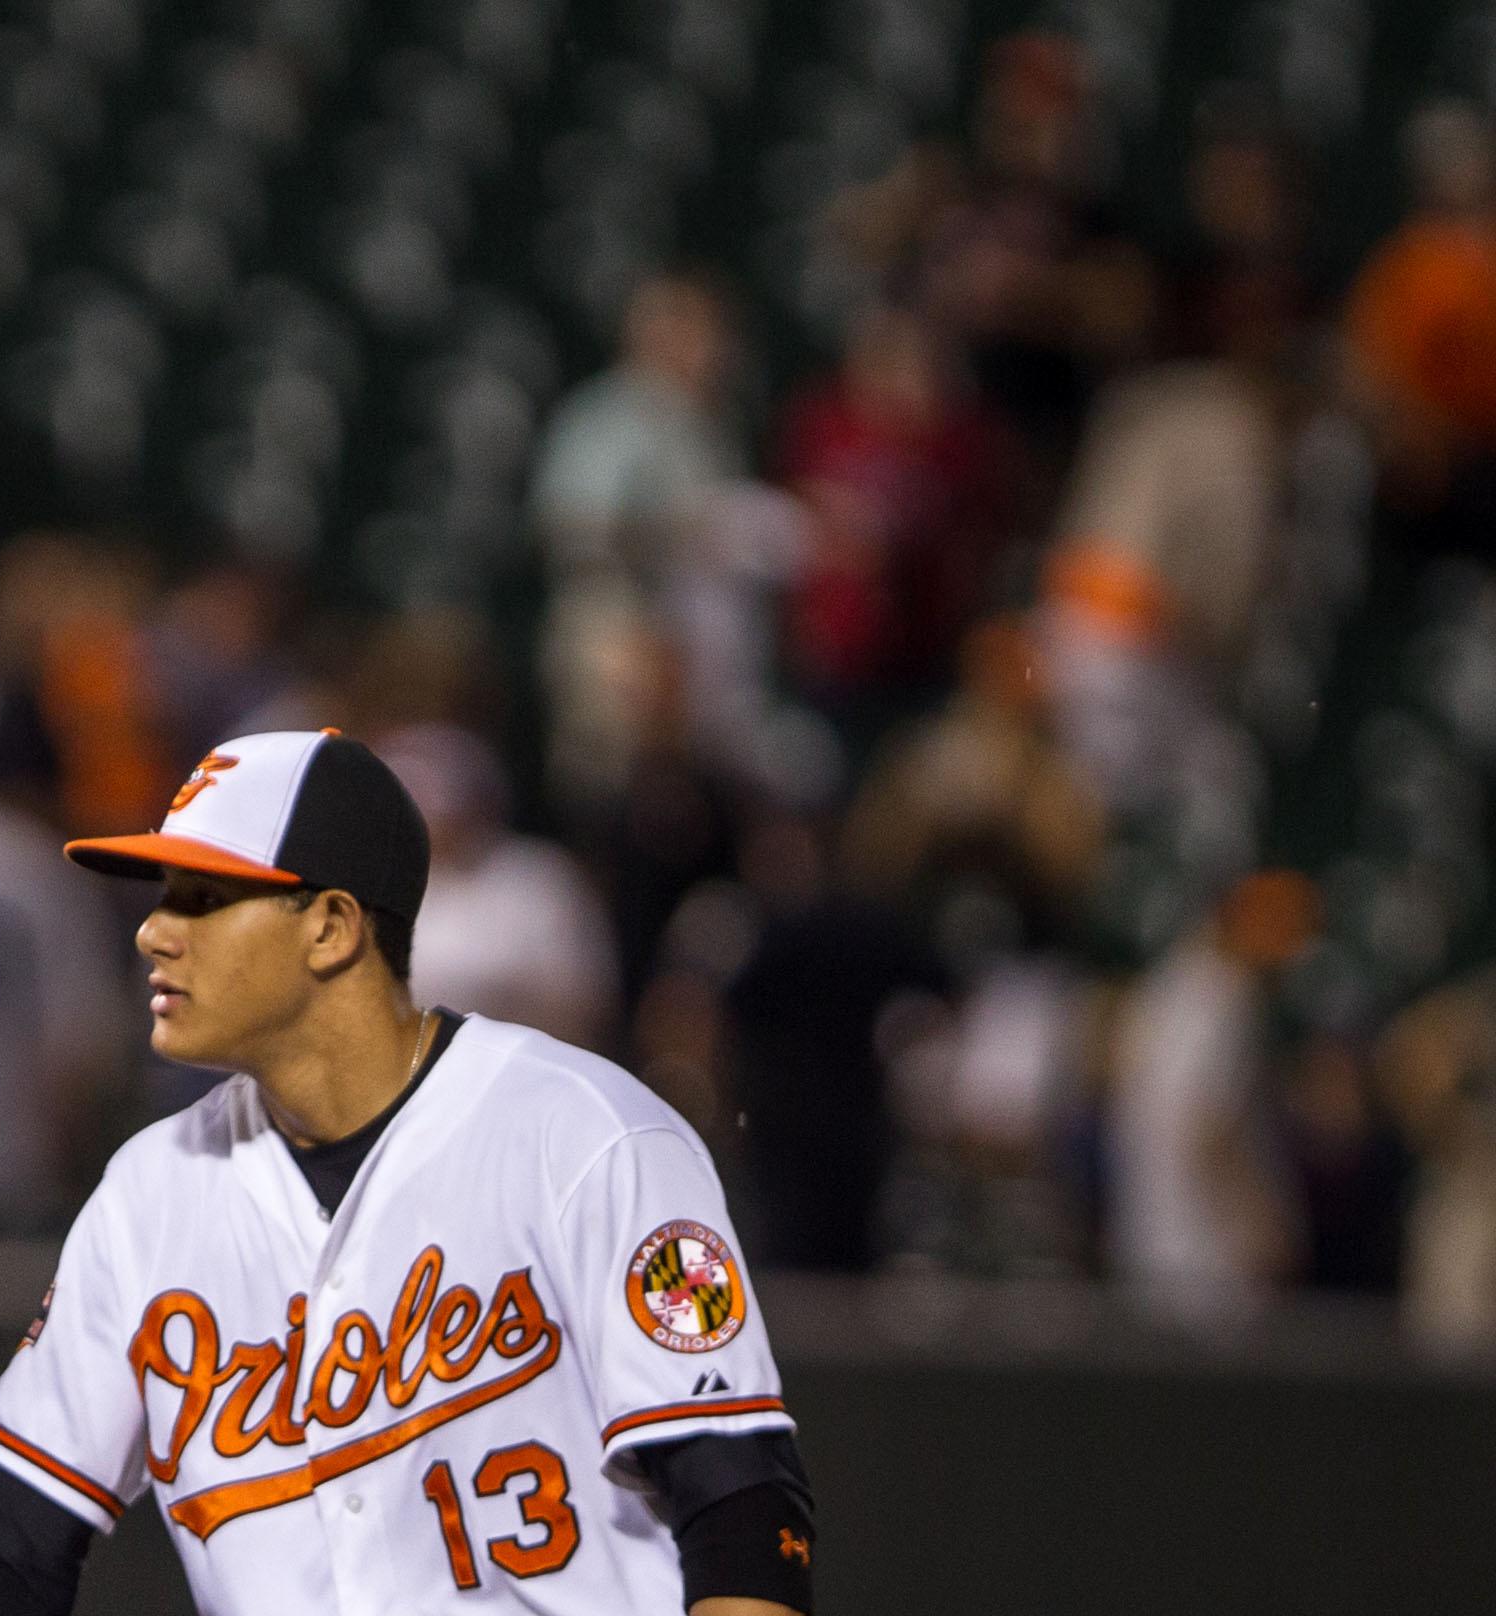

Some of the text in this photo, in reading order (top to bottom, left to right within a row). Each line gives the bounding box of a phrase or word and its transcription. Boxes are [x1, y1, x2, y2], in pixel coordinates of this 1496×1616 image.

[631, 1223, 732, 1276] BALTIMORE
[127, 1243, 560, 1484] Orioles
[651, 1316, 740, 1350] ORIOLES
[422, 1439, 581, 1591] 13
